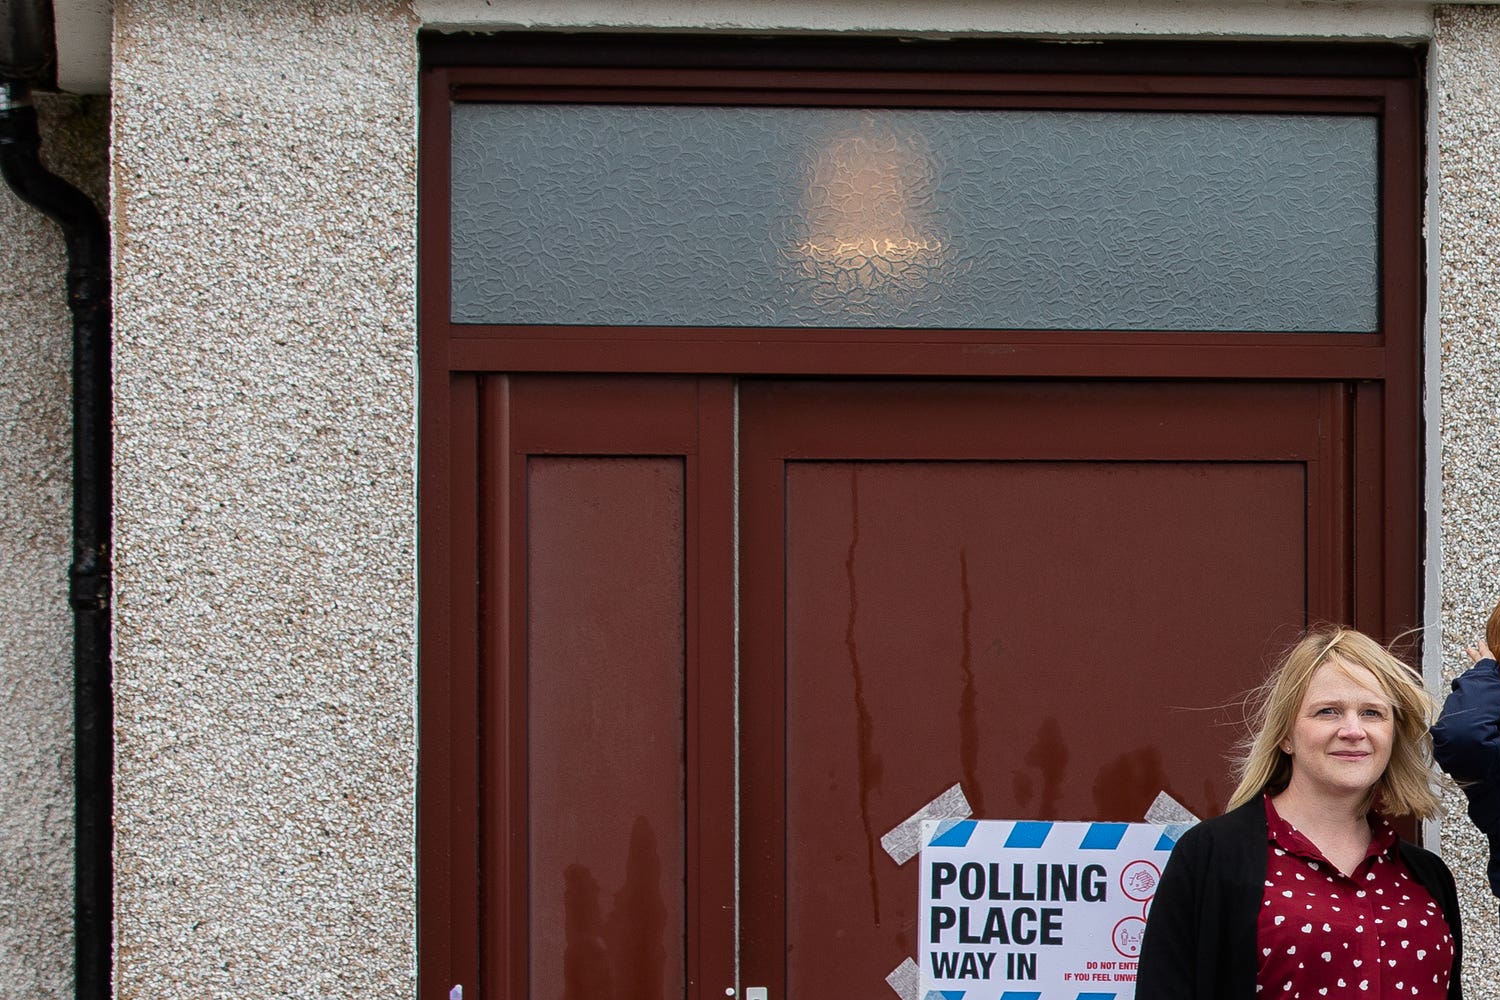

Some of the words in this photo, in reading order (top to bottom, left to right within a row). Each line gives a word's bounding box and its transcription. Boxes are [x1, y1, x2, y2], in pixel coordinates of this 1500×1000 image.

[931, 861, 1107, 902] POLLING
[930, 906, 1063, 945] PLACE
[930, 951, 997, 980] WAY
[1006, 952, 1037, 980] IN
[1064, 973, 1072, 981] IF
[1074, 973, 1090, 981] YOU
[1092, 973, 1111, 982] FEEL
[1113, 973, 1137, 982] UNWE
[1086, 961, 1098, 970] DO
[1100, 961, 1117, 970] NOT
[1118, 962, 1139, 970] ENTE
